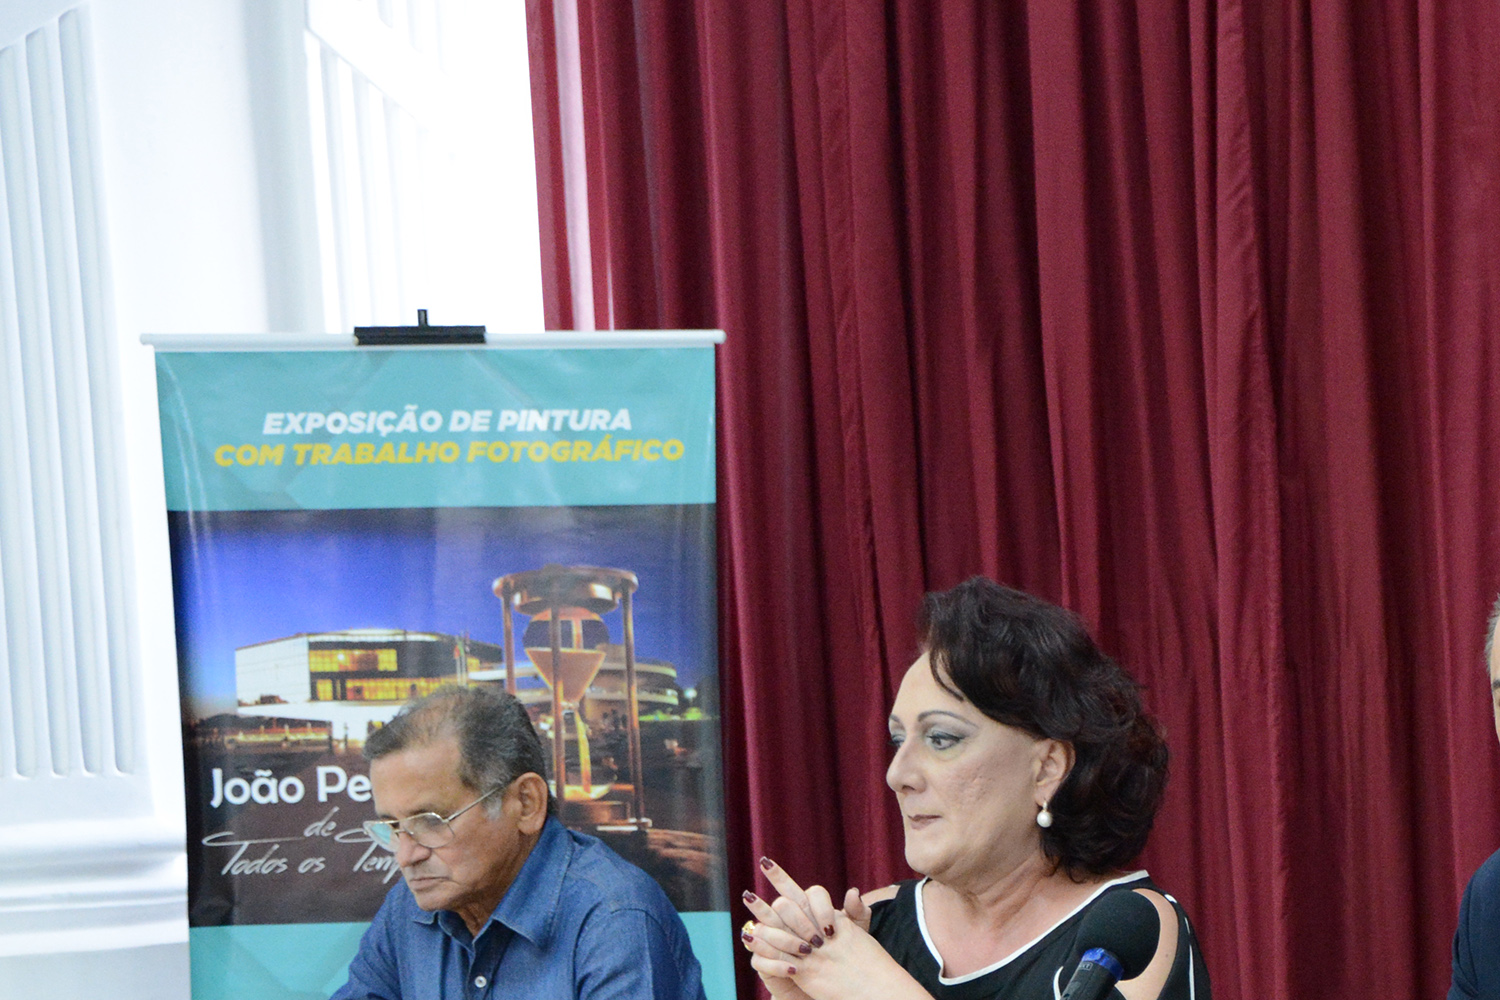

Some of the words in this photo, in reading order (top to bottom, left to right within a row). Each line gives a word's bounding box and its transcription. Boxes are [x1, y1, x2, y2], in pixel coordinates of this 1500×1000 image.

[262, 404, 444, 437] EXPOSIÇÃO
[448, 409, 493, 432] DE
[497, 408, 632, 432] PINTURA
[213, 443, 286, 467] COM
[292, 441, 461, 465] TRABALHO
[466, 433, 685, 463] FOTOGRÁFICO
[210, 767, 305, 809] João
[316, 765, 372, 802] Pe
[303, 806, 340, 837] de
[201, 831, 304, 875] Todos
[297, 856, 326, 874] os
